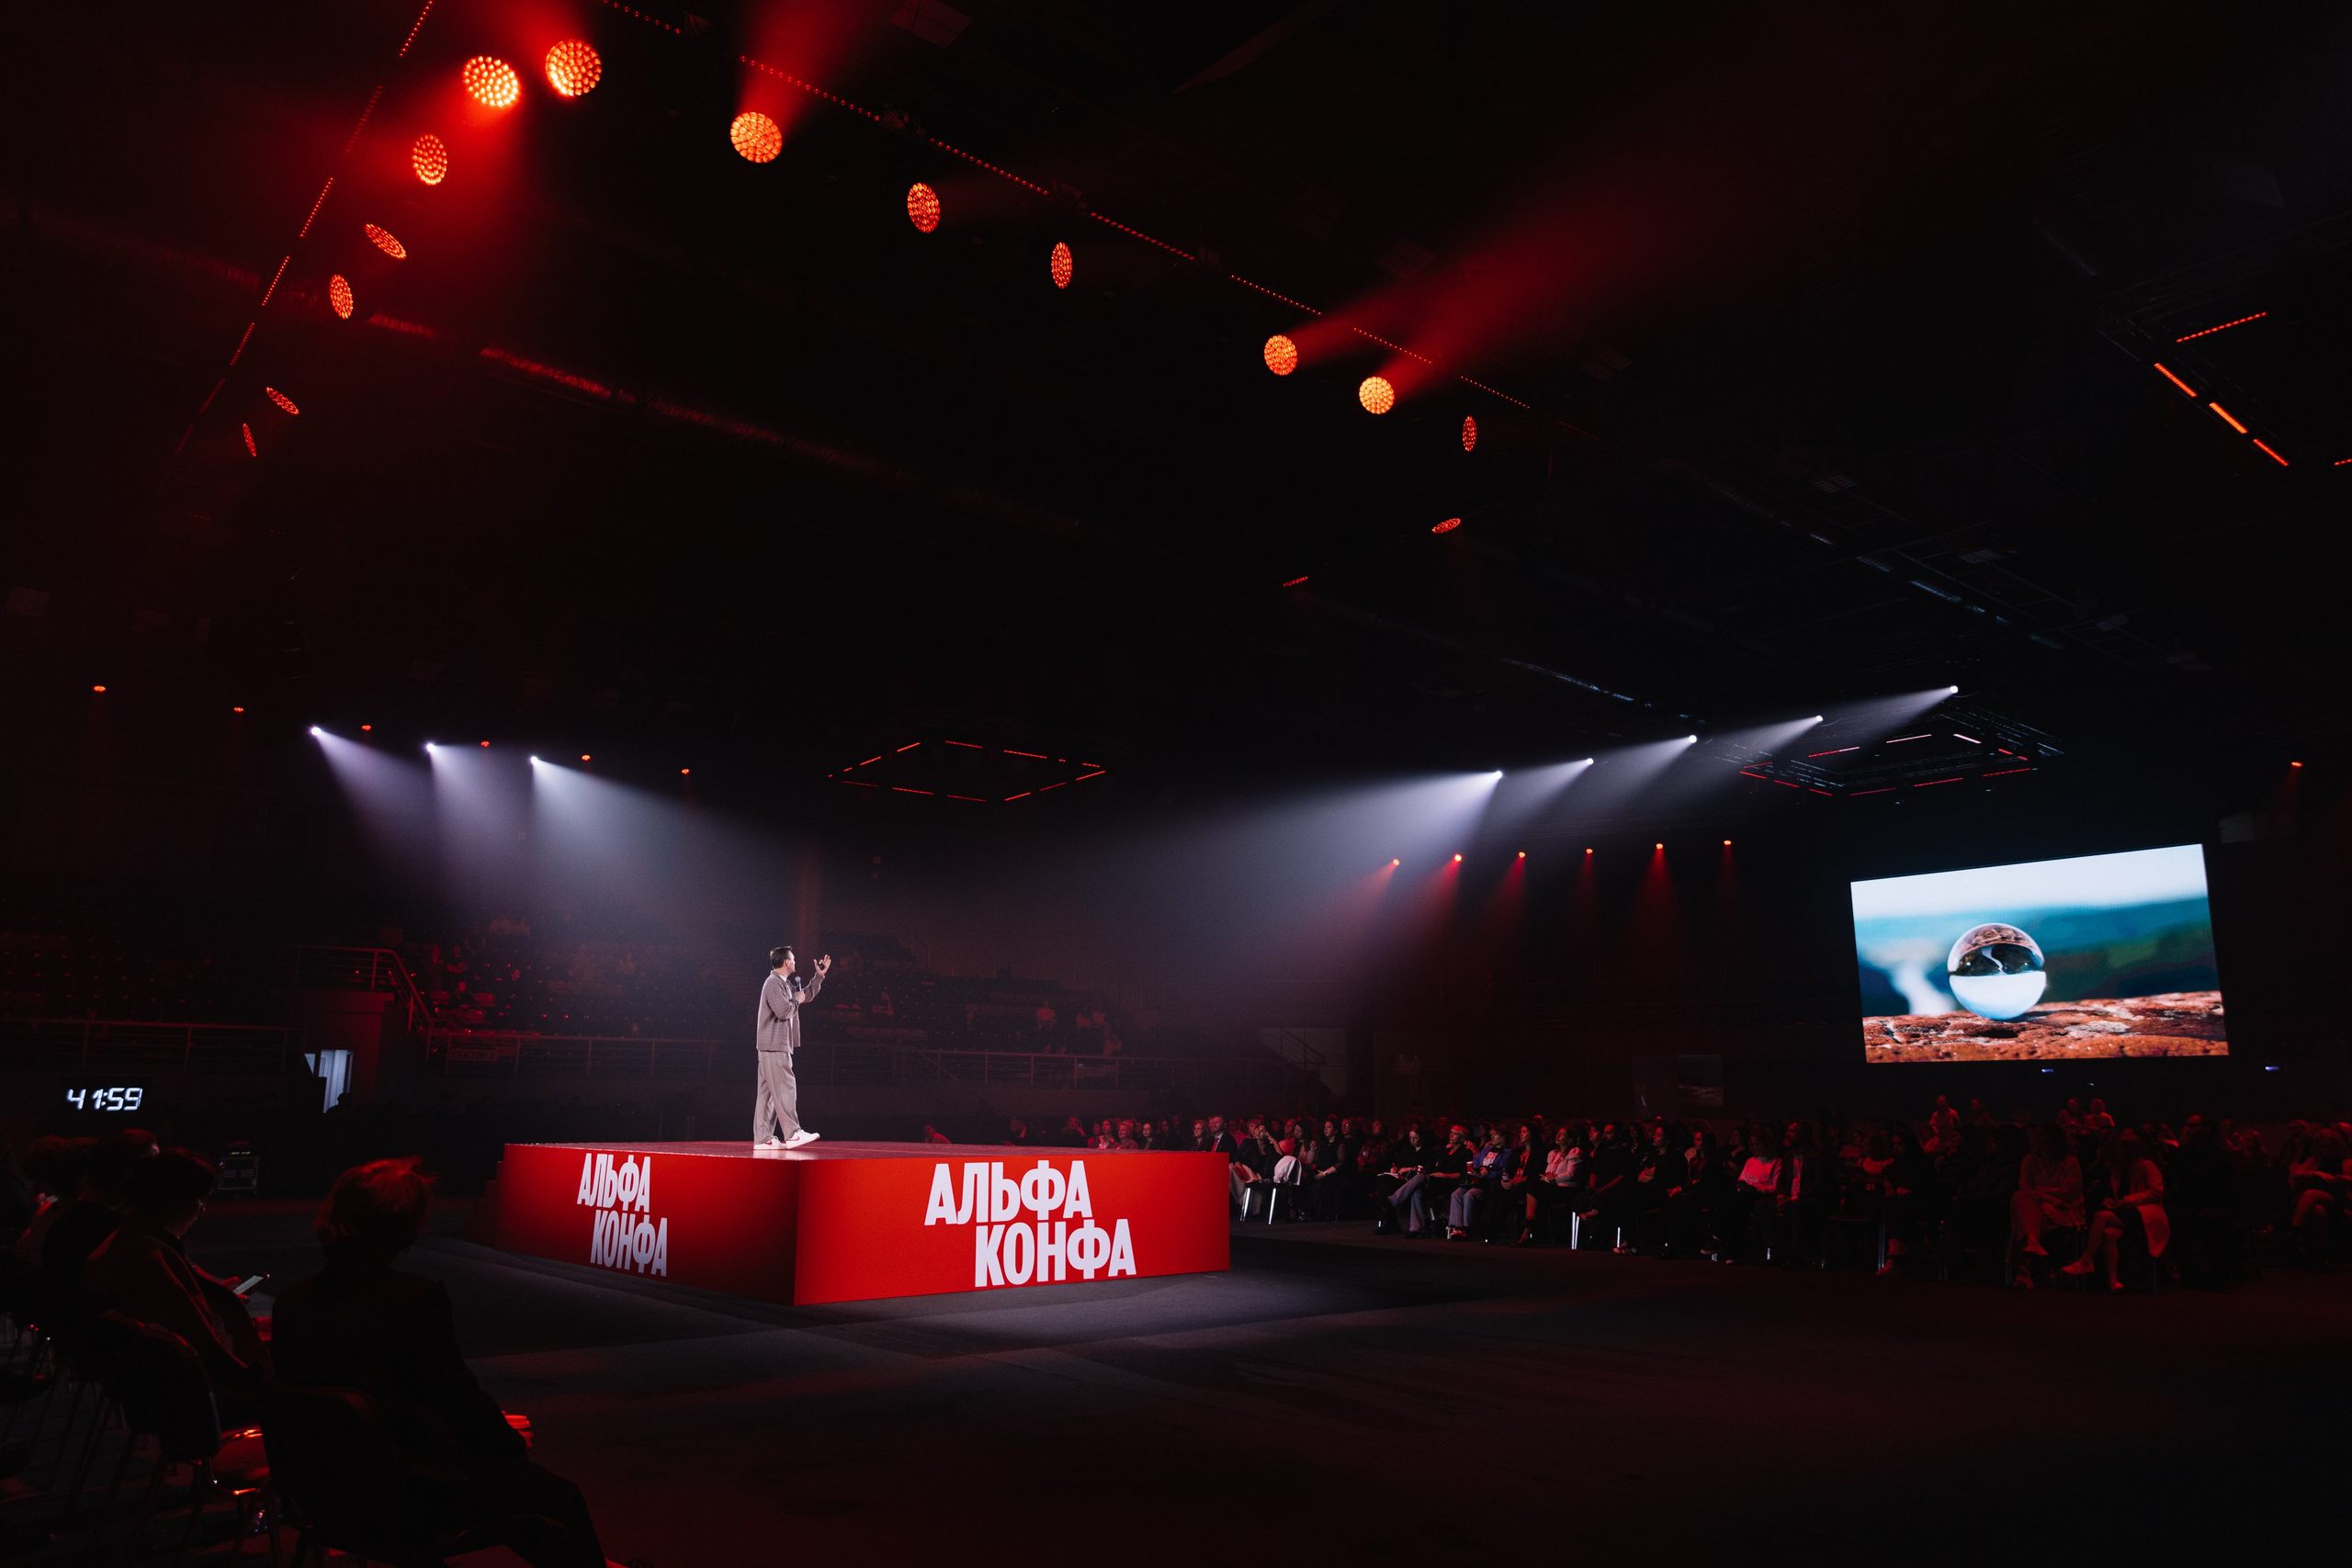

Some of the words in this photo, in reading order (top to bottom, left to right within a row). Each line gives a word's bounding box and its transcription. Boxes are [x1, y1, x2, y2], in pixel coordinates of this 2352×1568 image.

[66, 1088, 143, 1111] 41:59
[577, 1153, 650, 1213] АЛЬФА
[924, 1160, 1092, 1225] АЛЬФА
[590, 1209, 668, 1277] КОНФА
[975, 1219, 1137, 1288] КОНФА
